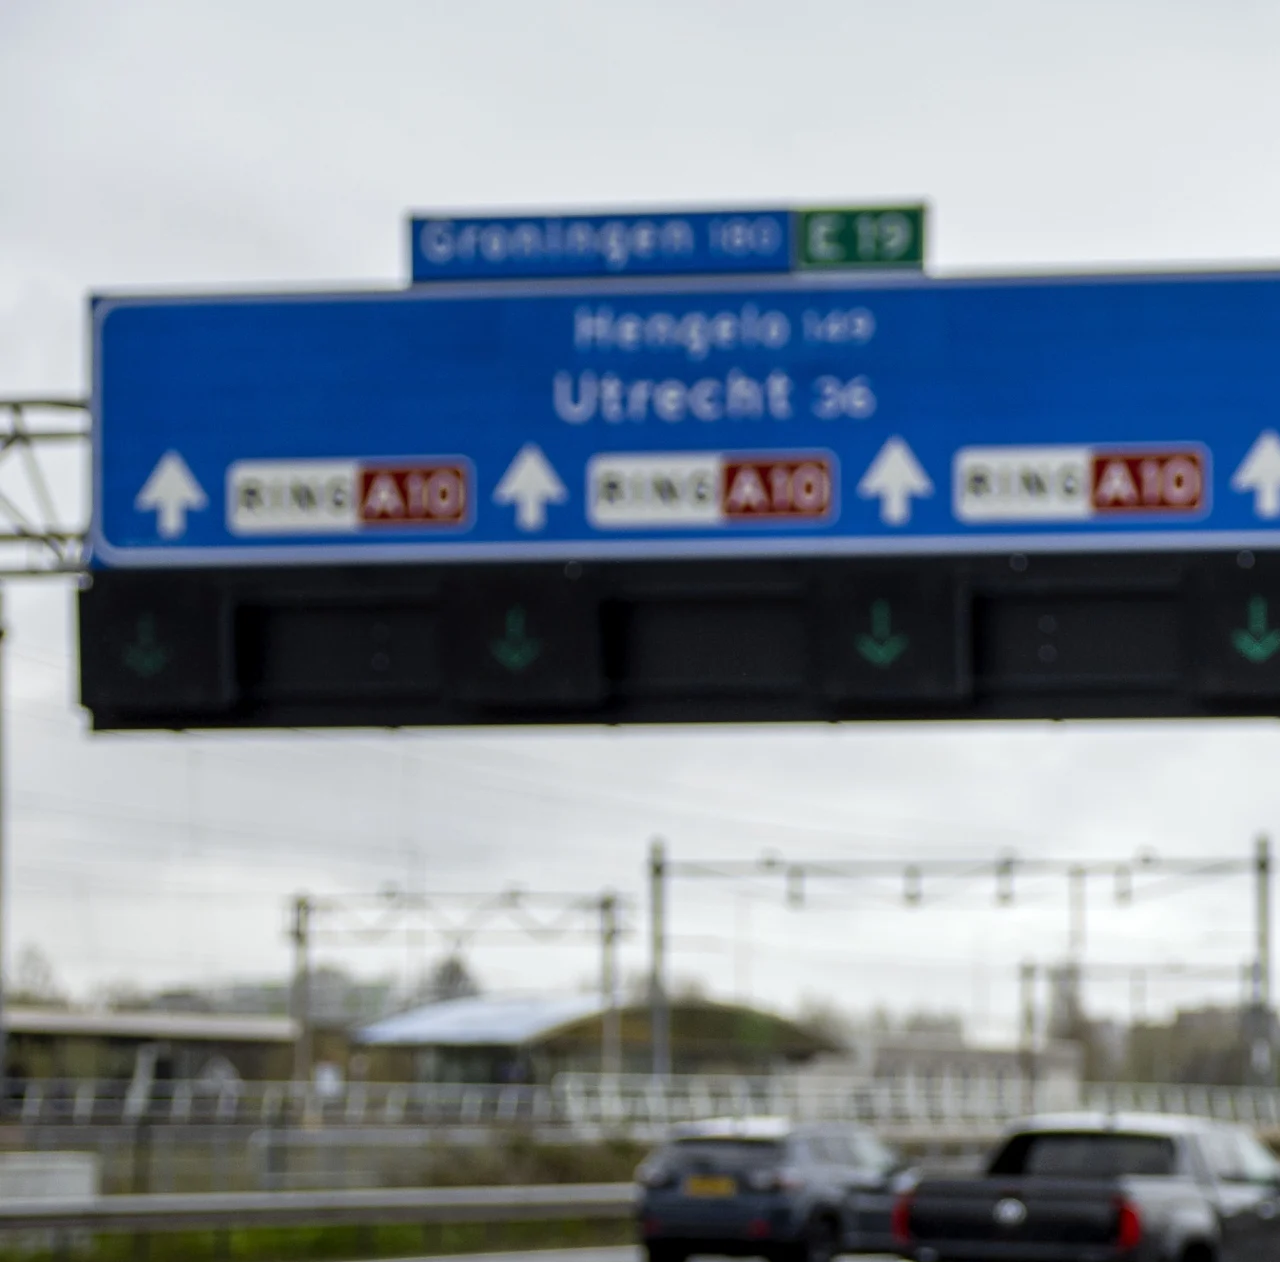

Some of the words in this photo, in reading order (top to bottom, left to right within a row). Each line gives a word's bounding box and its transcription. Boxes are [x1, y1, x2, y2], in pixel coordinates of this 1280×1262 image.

[421, 219, 694, 270] Groningen
[574, 306, 791, 359] Hengelo
[553, 370, 793, 423] Utrecht
[811, 373, 878, 422] 36
[235, 475, 351, 512] RING
[360, 468, 465, 516] A10
[598, 467, 714, 504] RING
[727, 462, 830, 514] A10
[965, 461, 1084, 499] RING
[1095, 457, 1200, 506] A10
